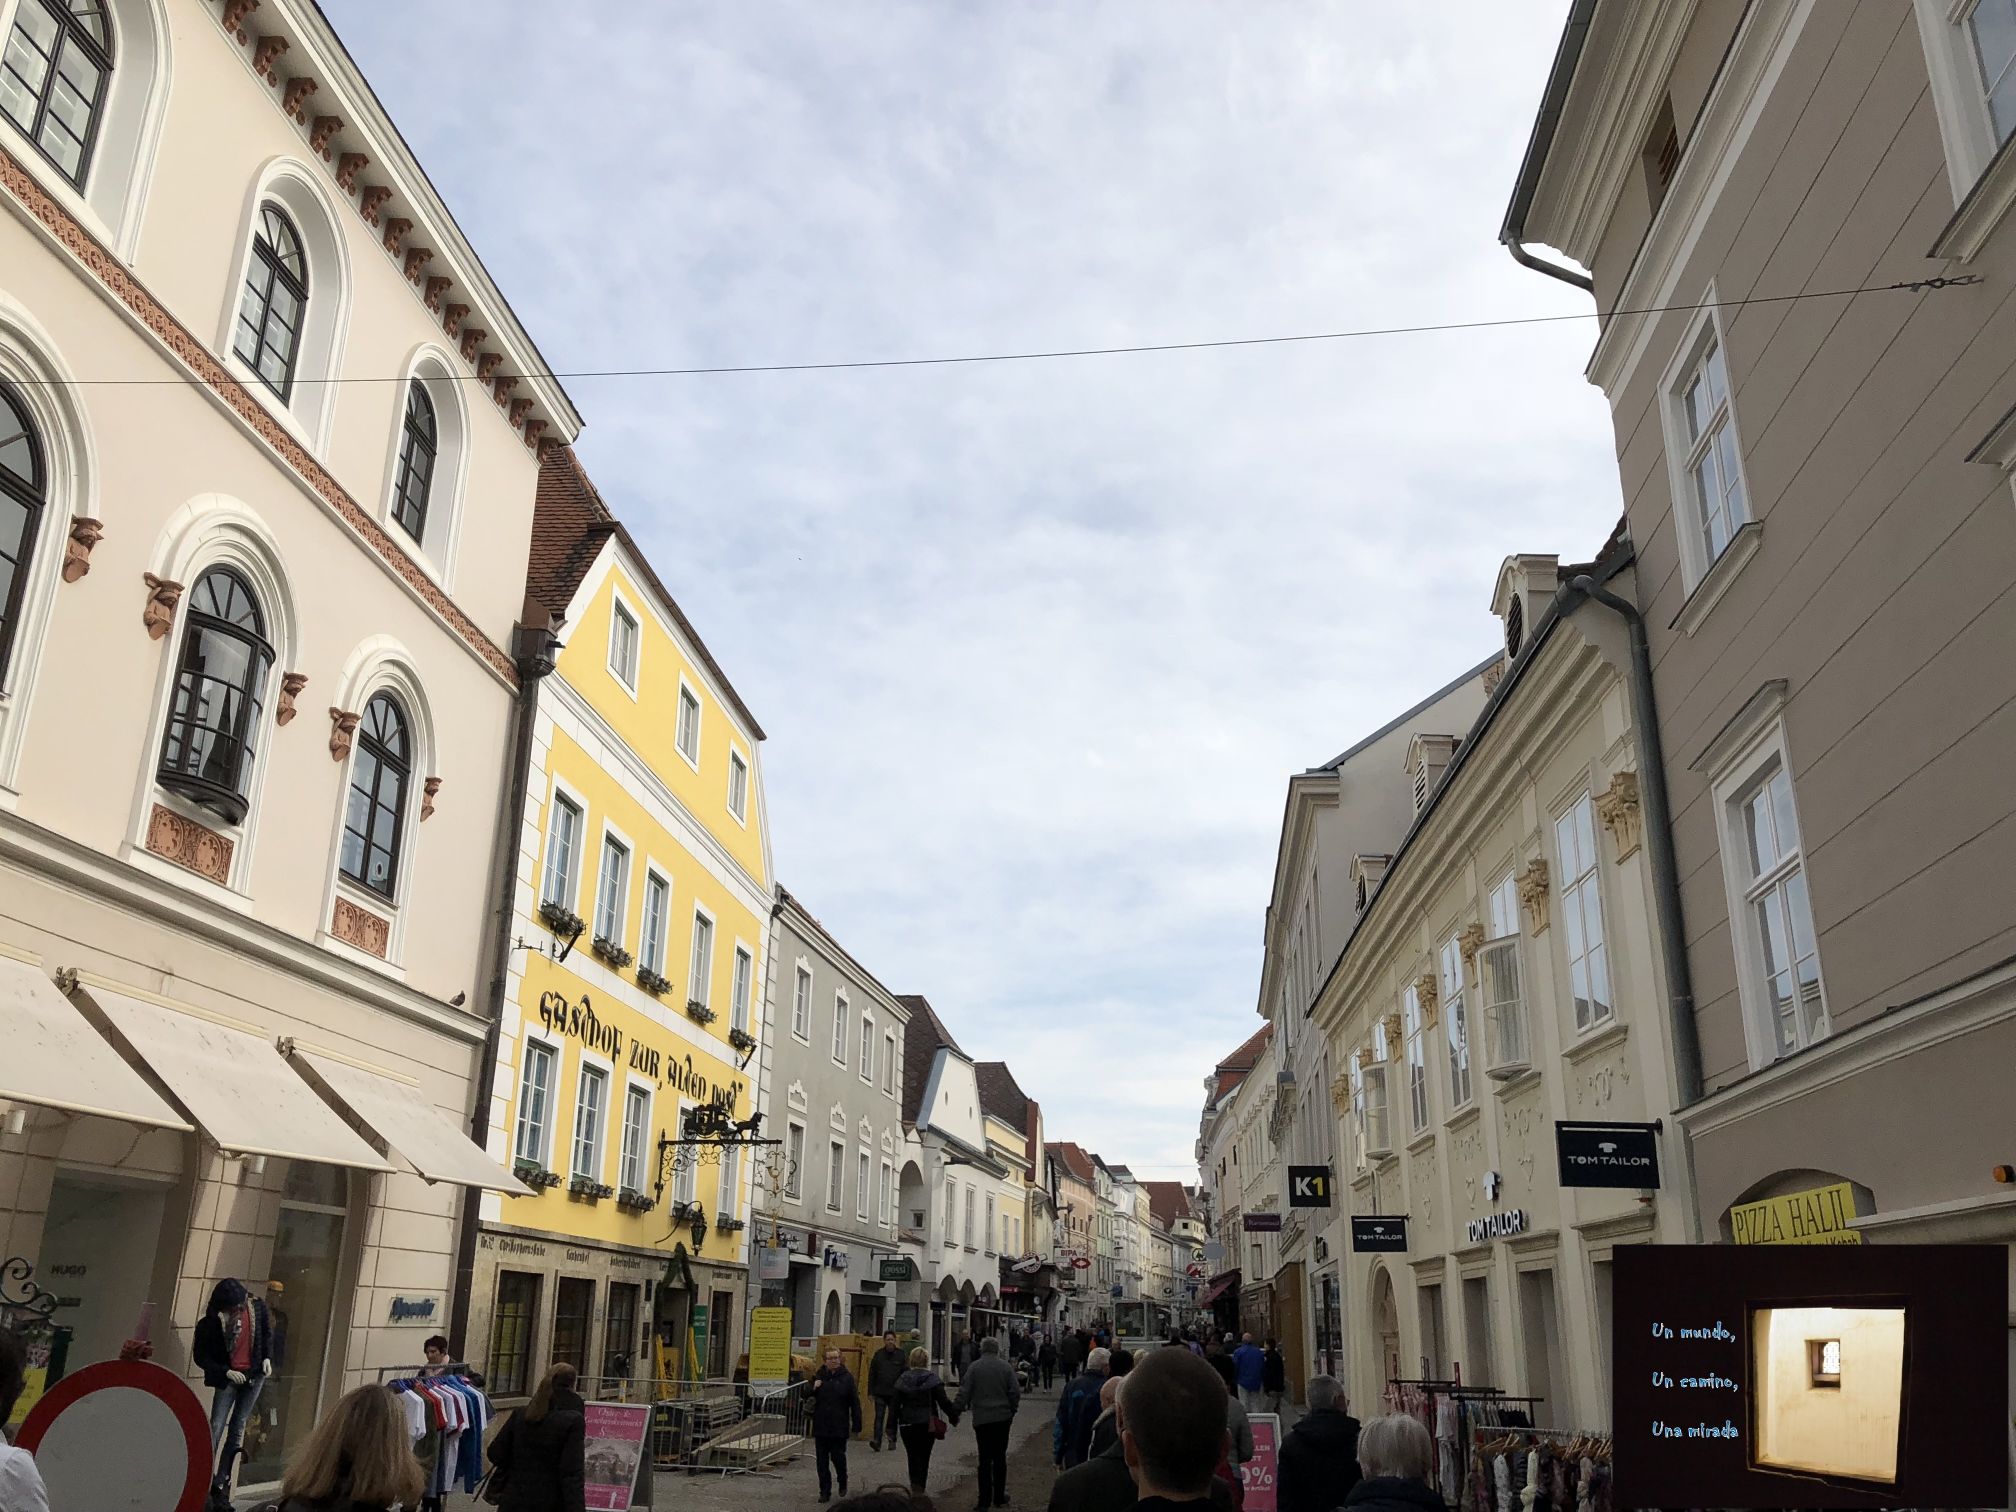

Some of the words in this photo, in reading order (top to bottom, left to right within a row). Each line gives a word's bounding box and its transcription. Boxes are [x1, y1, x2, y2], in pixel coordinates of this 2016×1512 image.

[1568, 1155, 1598, 1165] TOM
[1600, 1156, 1650, 1166] TAILOR
[1295, 1176, 1324, 1196] K1
[1465, 1217, 1485, 1243] TOM
[1485, 1209, 1522, 1239] TAILOR
[1734, 1204, 1784, 1245] PIZZA
[49, 1264, 87, 1276] HUGO
